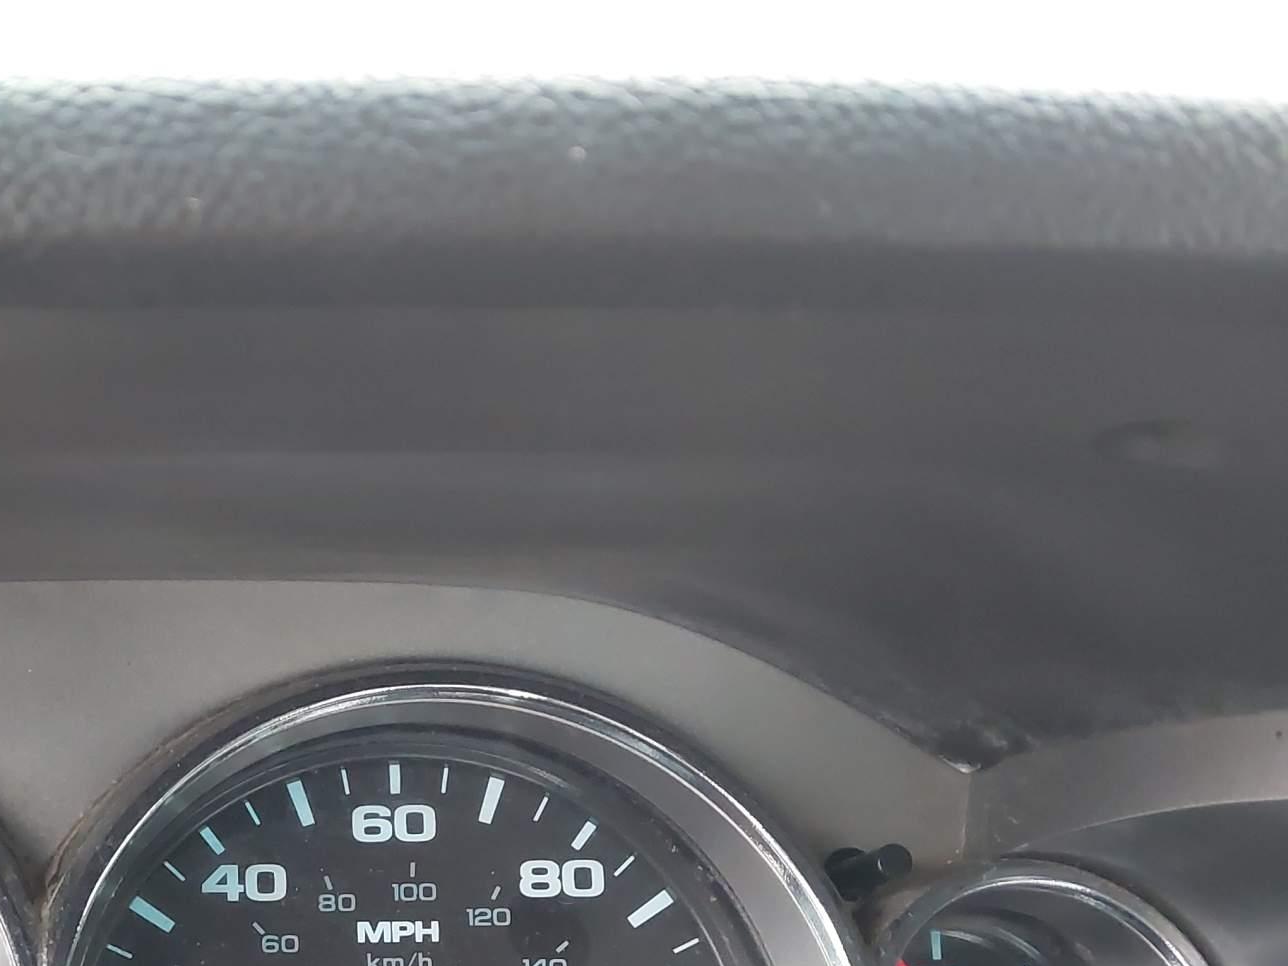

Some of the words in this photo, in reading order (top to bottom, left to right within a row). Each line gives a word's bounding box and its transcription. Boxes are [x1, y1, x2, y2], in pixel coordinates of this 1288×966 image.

[351, 805, 436, 843] 60
[201, 864, 286, 901] 40
[519, 859, 605, 897] 80
[391, 882, 437, 901] 100
[317, 893, 357, 913] 80
[466, 907, 511, 927] 120
[357, 920, 440, 943] MPH
[261, 934, 300, 954] 60
